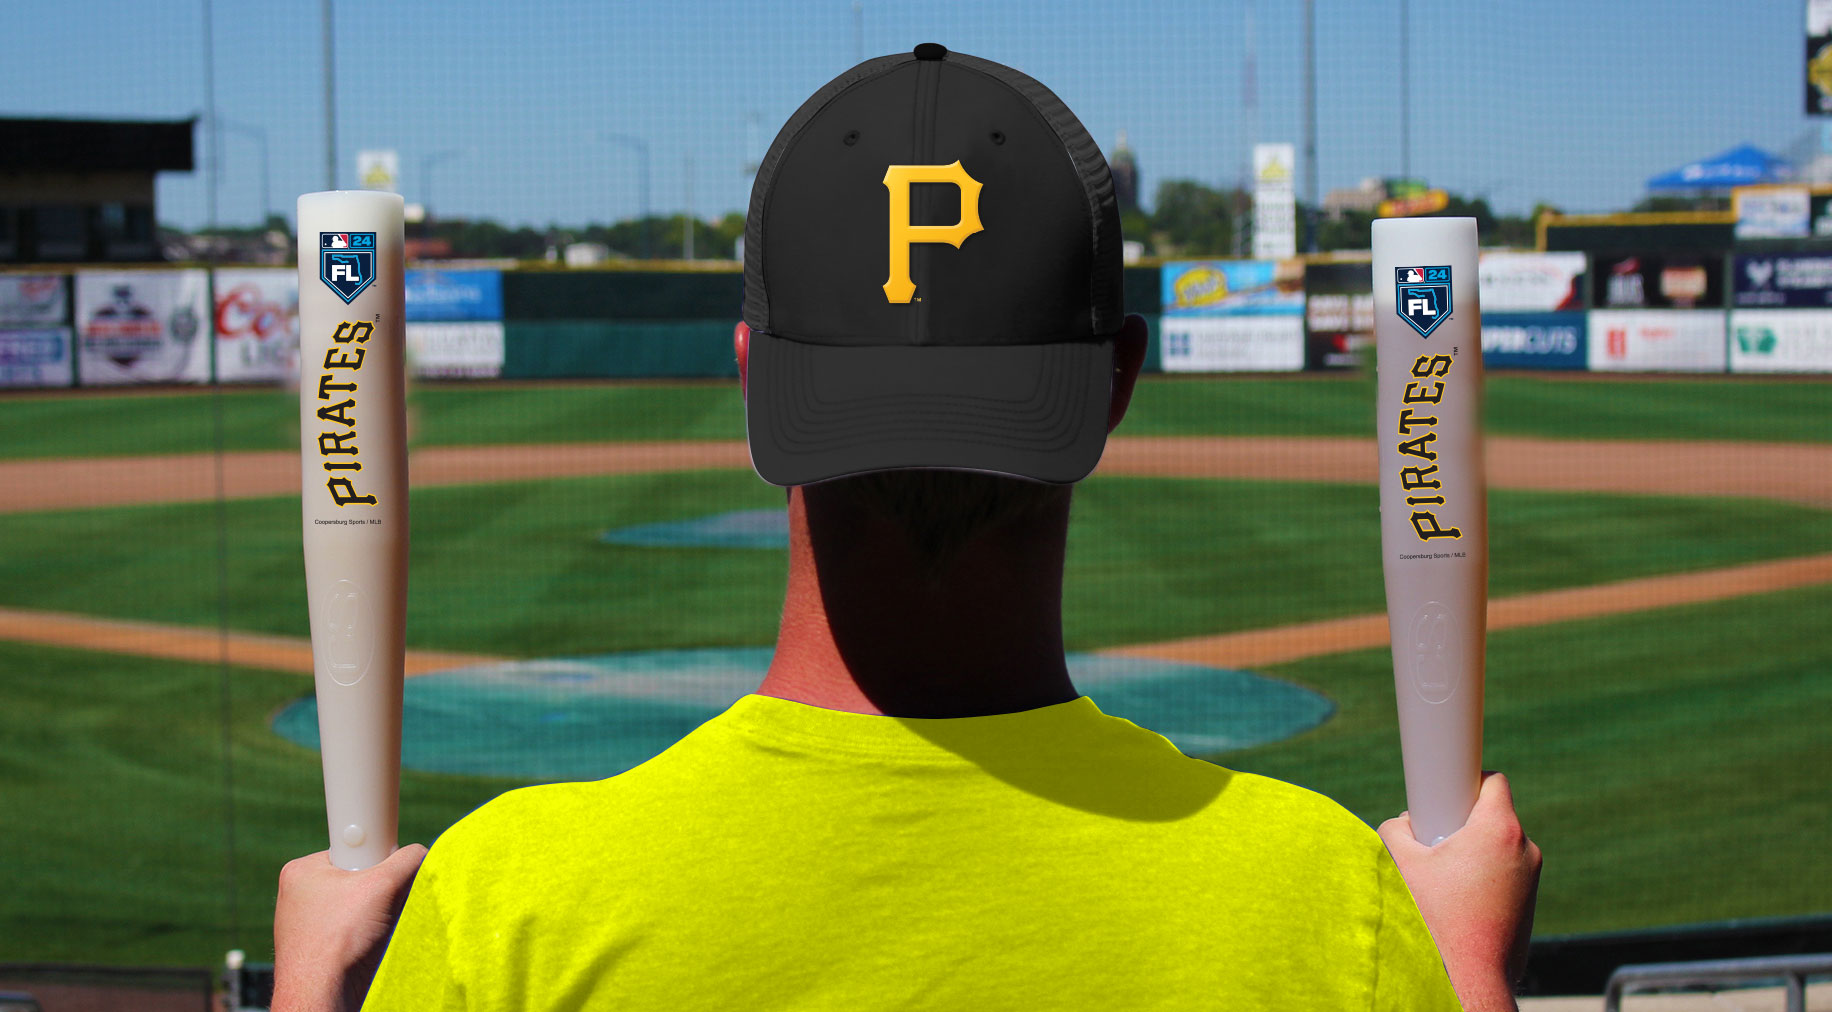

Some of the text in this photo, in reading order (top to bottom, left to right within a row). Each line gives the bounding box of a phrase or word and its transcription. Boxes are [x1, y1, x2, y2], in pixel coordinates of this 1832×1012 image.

[882, 159, 985, 304] P
[352, 236, 372, 247] 24
[331, 264, 360, 282] FL
[1428, 269, 1447, 280] 24
[1407, 298, 1437, 316] FL
[316, 320, 379, 507] PIRATES
[1398, 353, 1463, 542] PIRATES
